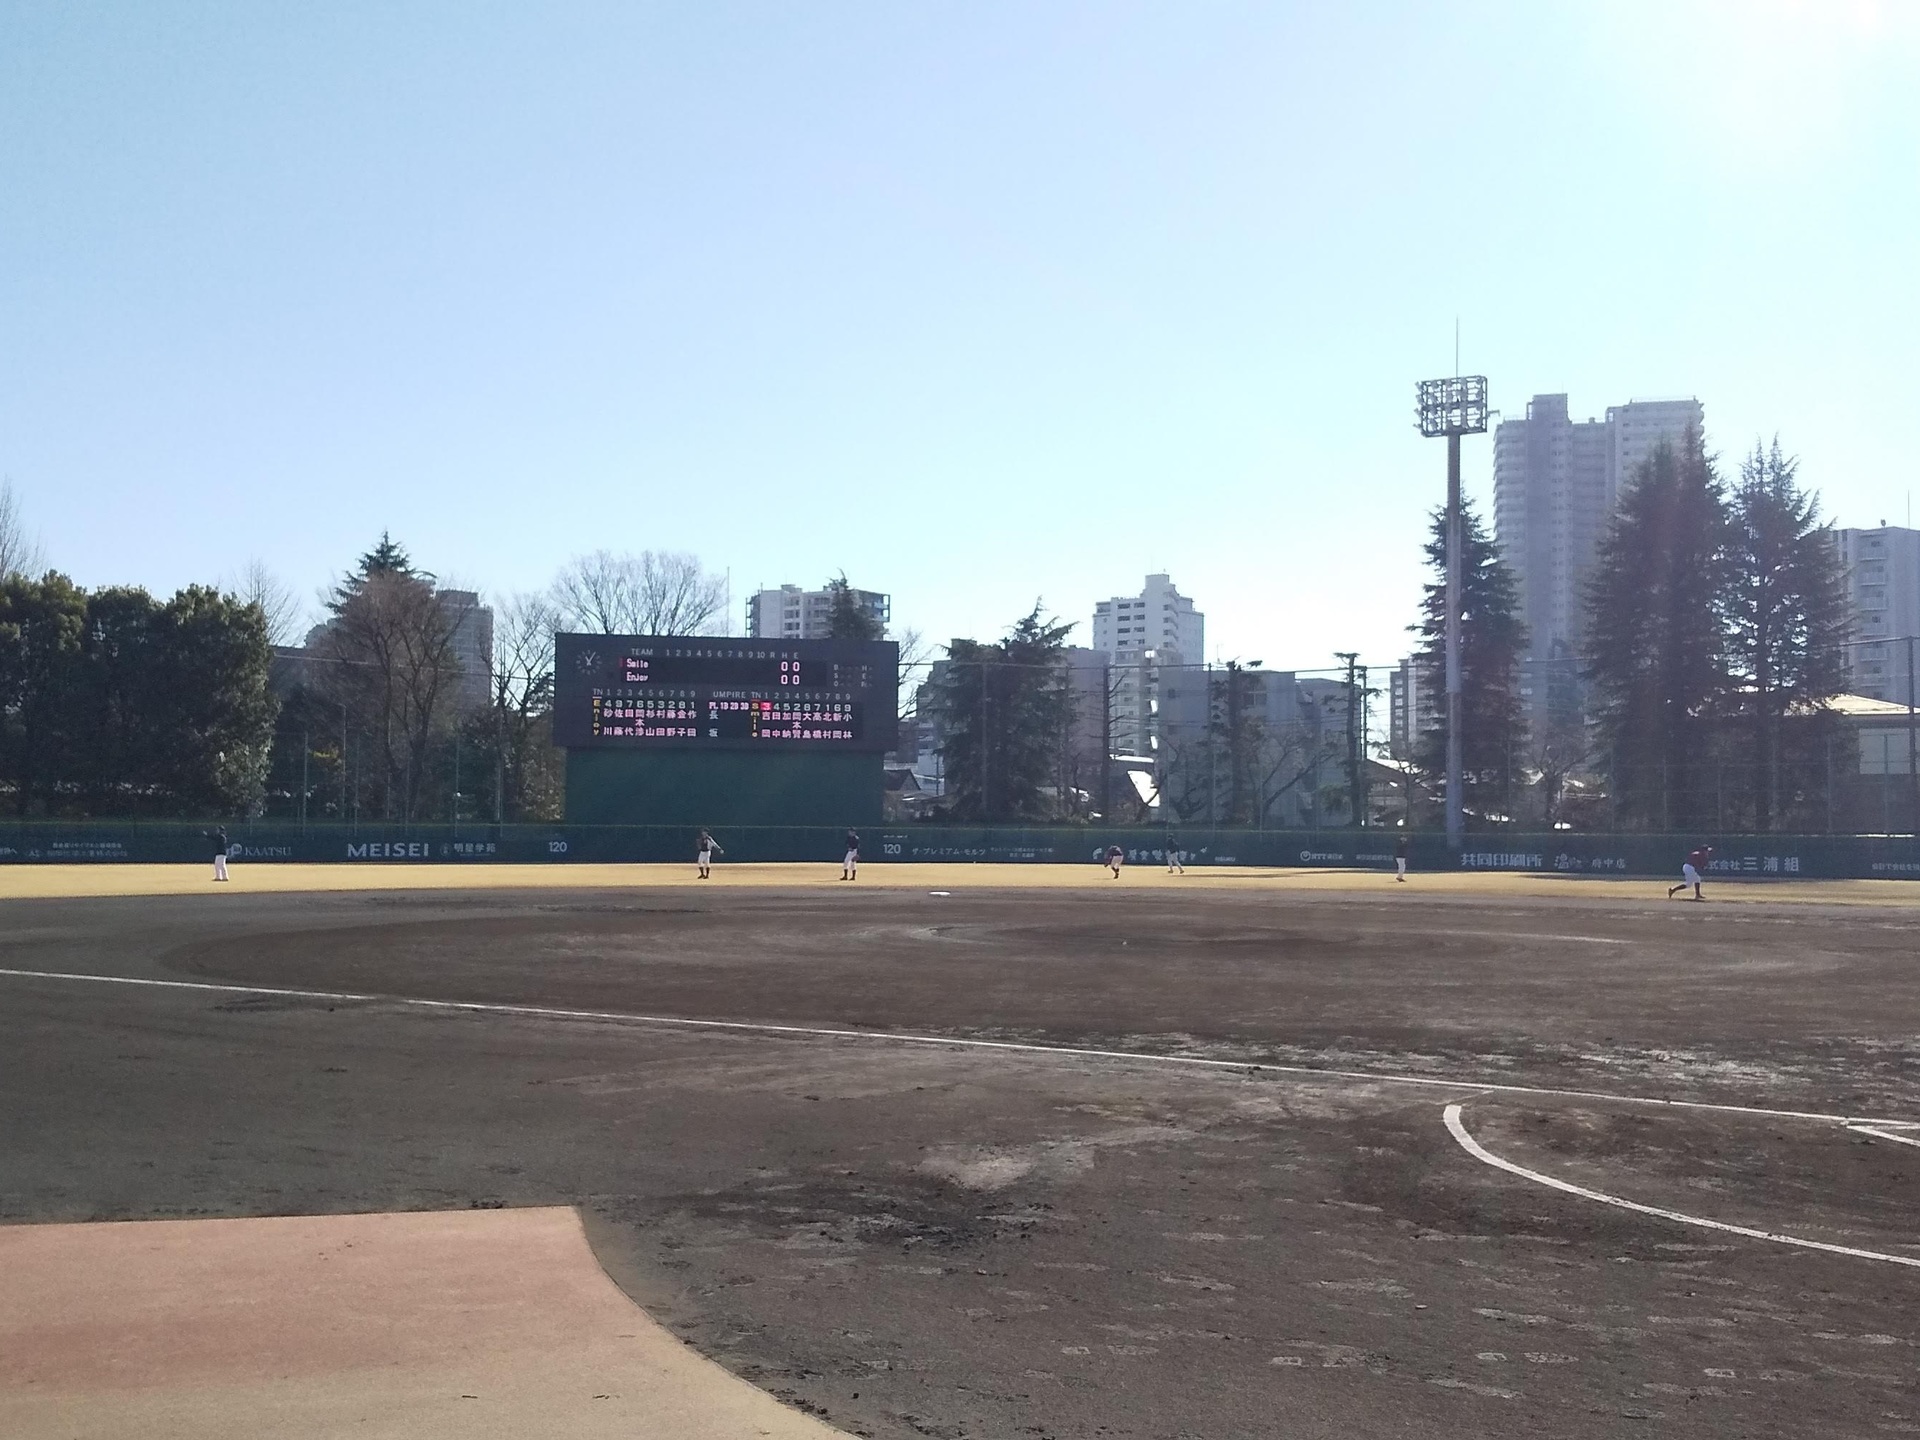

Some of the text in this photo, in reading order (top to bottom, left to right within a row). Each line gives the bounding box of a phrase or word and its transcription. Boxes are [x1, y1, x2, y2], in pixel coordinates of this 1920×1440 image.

[781, 662, 788, 671] 0
[792, 662, 800, 671] 0
[781, 675, 788, 685] 0
[792, 675, 800, 685] 0
[244, 846, 292, 857] KAATSU
[348, 843, 429, 857] MEISEI
[548, 842, 568, 853] 120
[883, 844, 901, 854] 120
[1461, 853, 1543, 867] 共同印刷所
[1703, 857, 1799, 872] 式会社 三浦組
